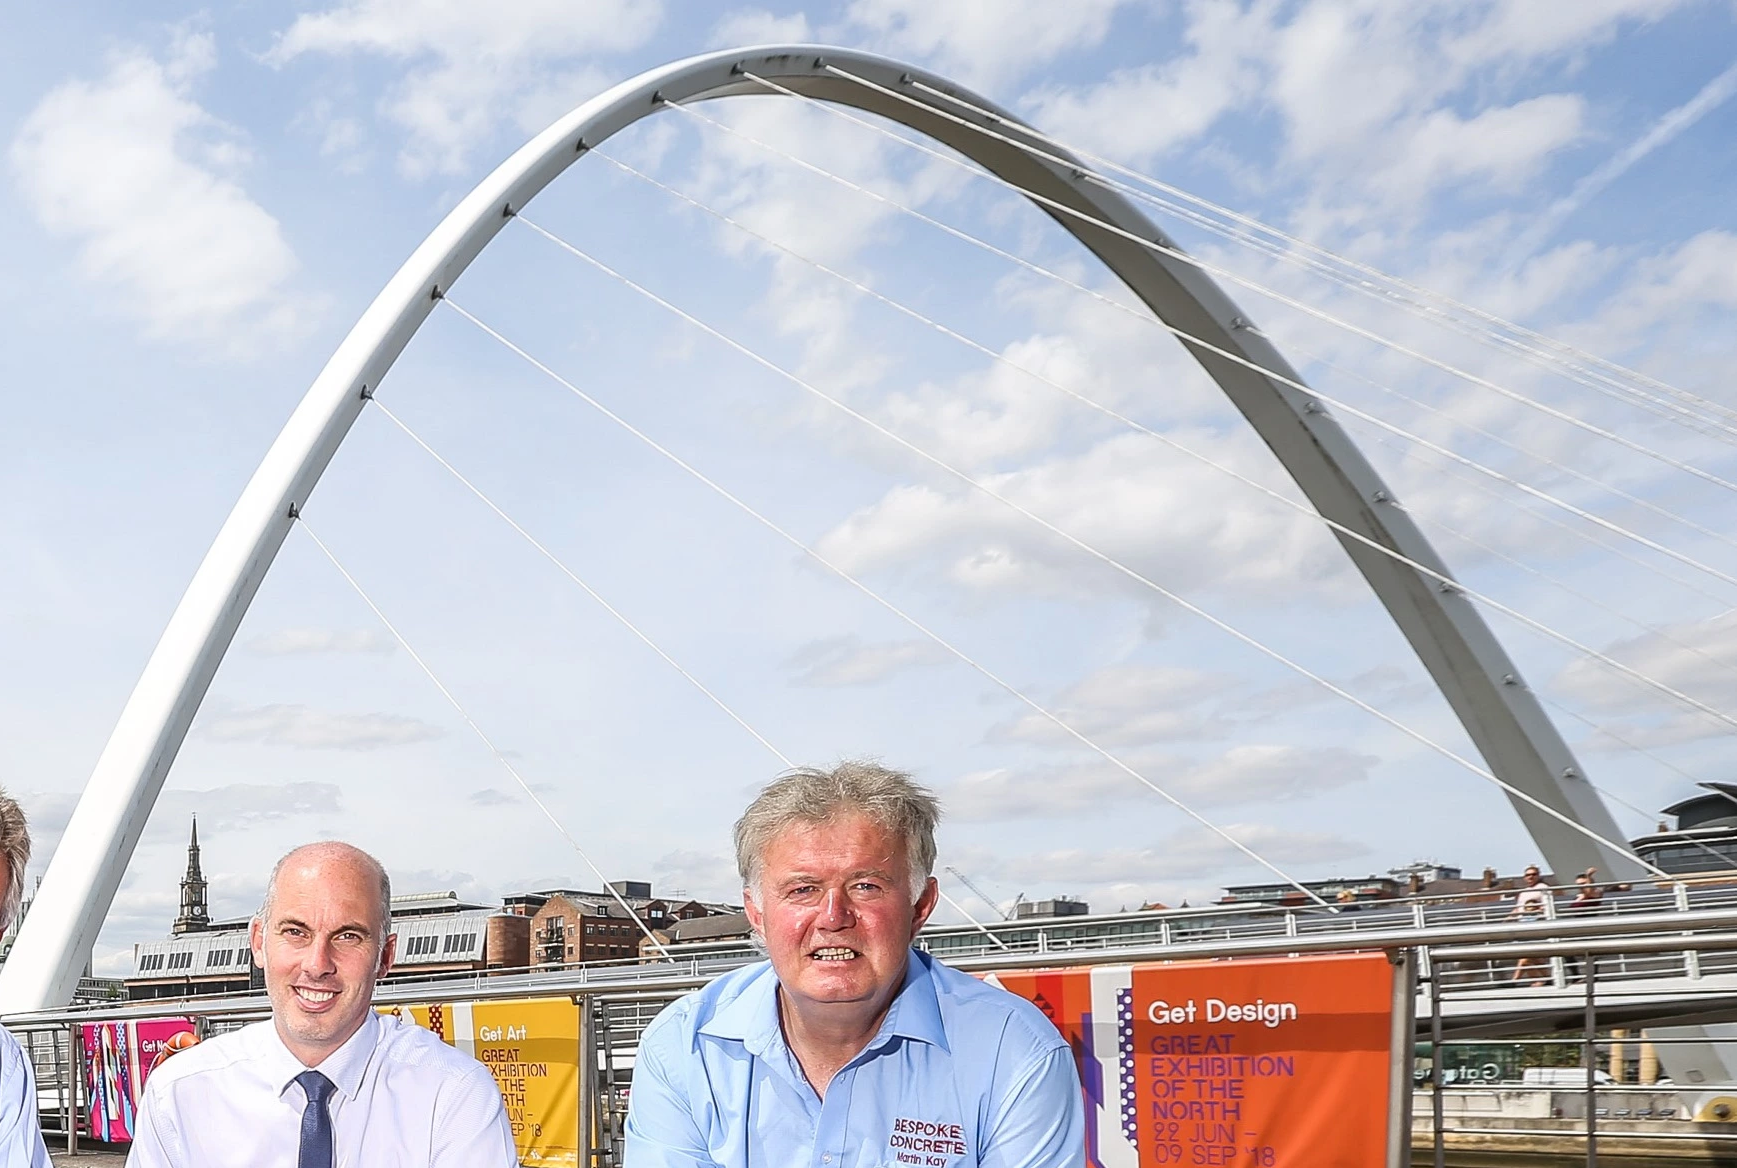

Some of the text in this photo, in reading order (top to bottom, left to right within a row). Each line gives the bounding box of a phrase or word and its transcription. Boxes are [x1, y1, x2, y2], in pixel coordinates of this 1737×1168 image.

[1148, 999, 1297, 1028] Get Design
[479, 1024, 527, 1042] Get Art
[142, 1039, 156, 1053] Get
[1150, 1034, 1236, 1055] GREAT
[481, 1048, 520, 1063] GREAT
[484, 1063, 547, 1077] XHIBITION
[1150, 1055, 1294, 1077] EXHIBITION
[501, 1078, 526, 1092] THE
[1152, 1078, 1244, 1099] OF THE
[505, 1108, 523, 1121] UN
[1152, 1101, 1240, 1121] NORTH
[894, 1118, 963, 1139] BESPOKE
[1154, 1122, 1180, 1142] 22
[1189, 1123, 1235, 1144] JUN
[890, 1134, 967, 1155] CONCRETE
[1154, 1143, 1182, 1164] 09
[1192, 1145, 1236, 1166] SEP
[897, 1151, 947, 1168] Martin Kay
